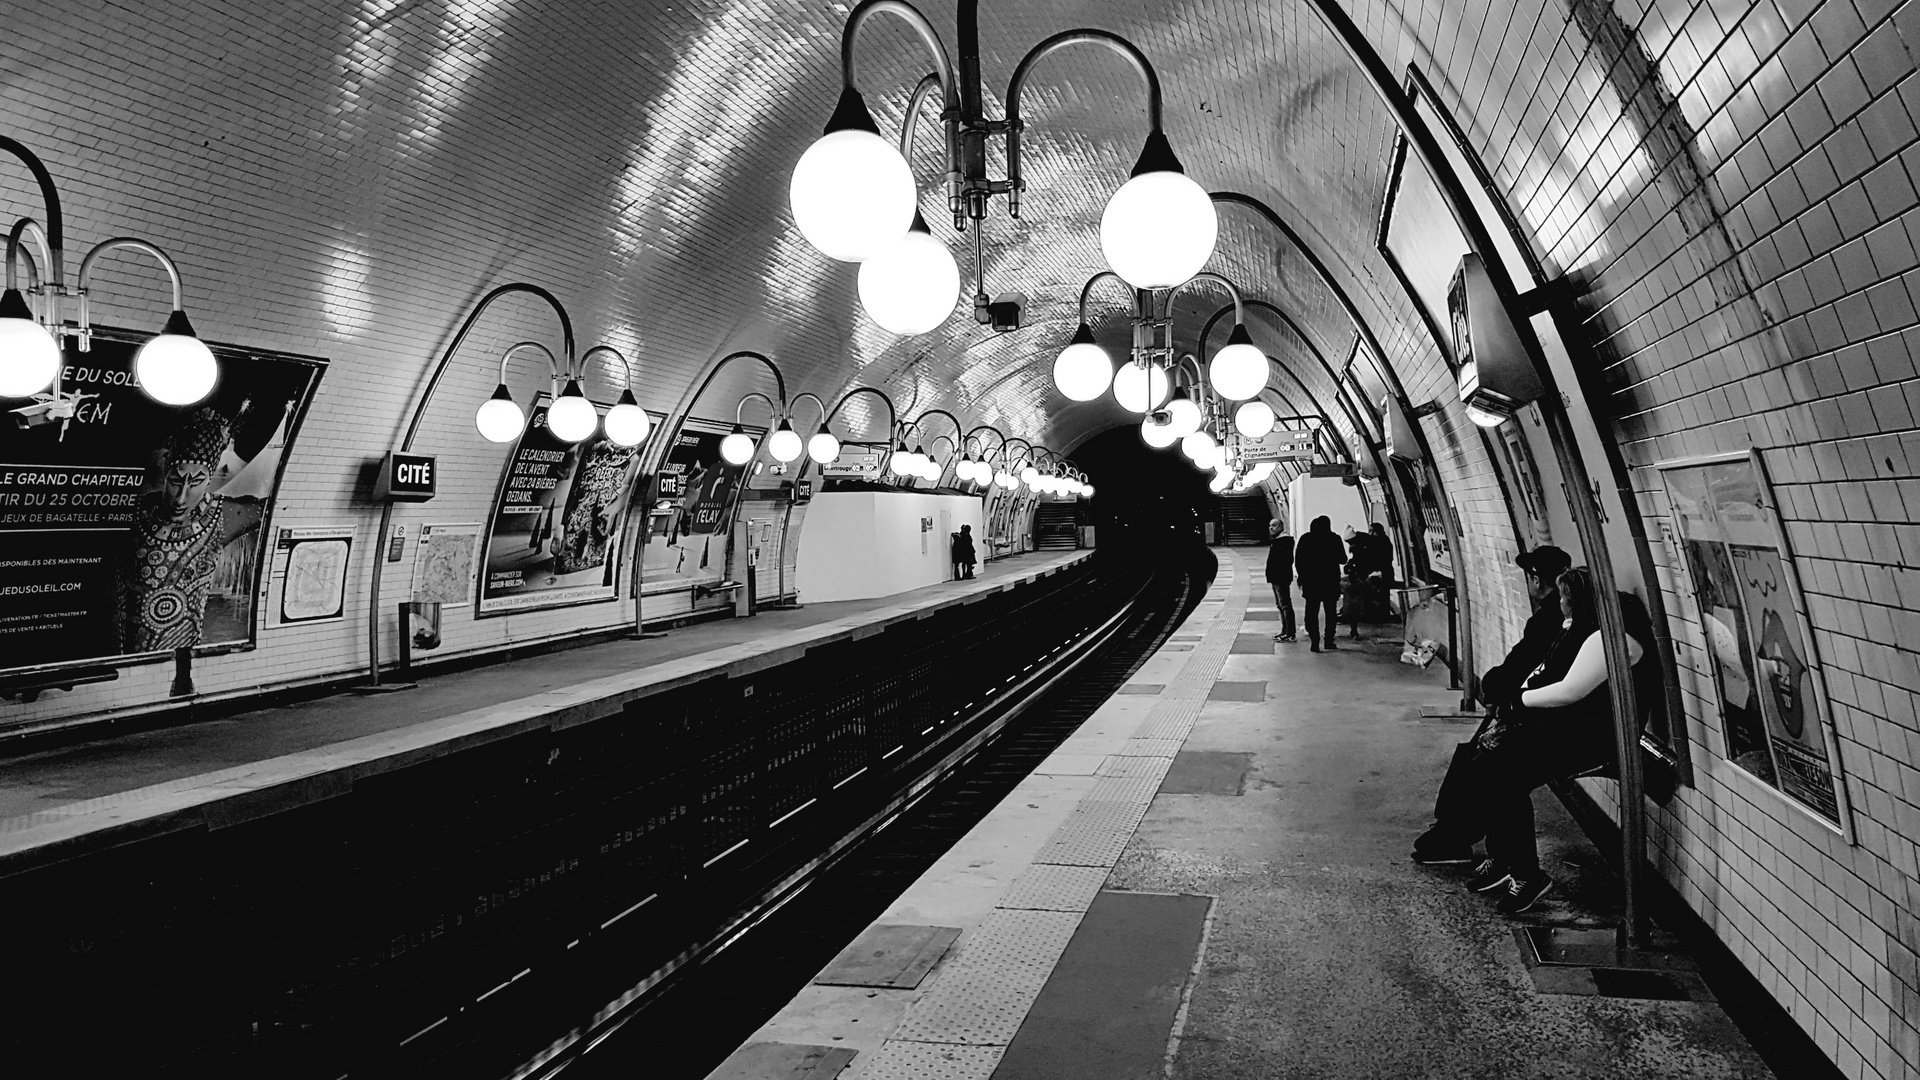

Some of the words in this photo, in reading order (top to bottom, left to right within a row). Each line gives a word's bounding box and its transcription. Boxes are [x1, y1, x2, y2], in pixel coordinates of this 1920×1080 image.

[76, 368, 101, 382] DU
[519, 448, 530, 460] LE
[528, 449, 565, 462] CALENDRIER
[398, 462, 430, 484] CITÉ
[515, 462, 526, 474] DE
[524, 462, 550, 475] L'AVENT
[17, 473, 68, 485] GRAND
[71, 473, 144, 486] CHAPITEAU
[510, 476, 528, 488] AVEC
[527, 477, 537, 489] 24
[535, 476, 557, 489] BIÈRES
[661, 477, 677, 493] CITÉ
[799, 484, 810, 496] CITÉ
[24, 493, 46, 506] DU
[49, 493, 68, 506] 25
[71, 493, 138, 506] OCTOBRE
[0, 513, 28, 523] JEUX
[29, 513, 43, 523] DE
[45, 513, 100, 523] BAGATELLE
[107, 513, 134, 522] PARIS
[58, 557, 102, 565] MAINTENANT
